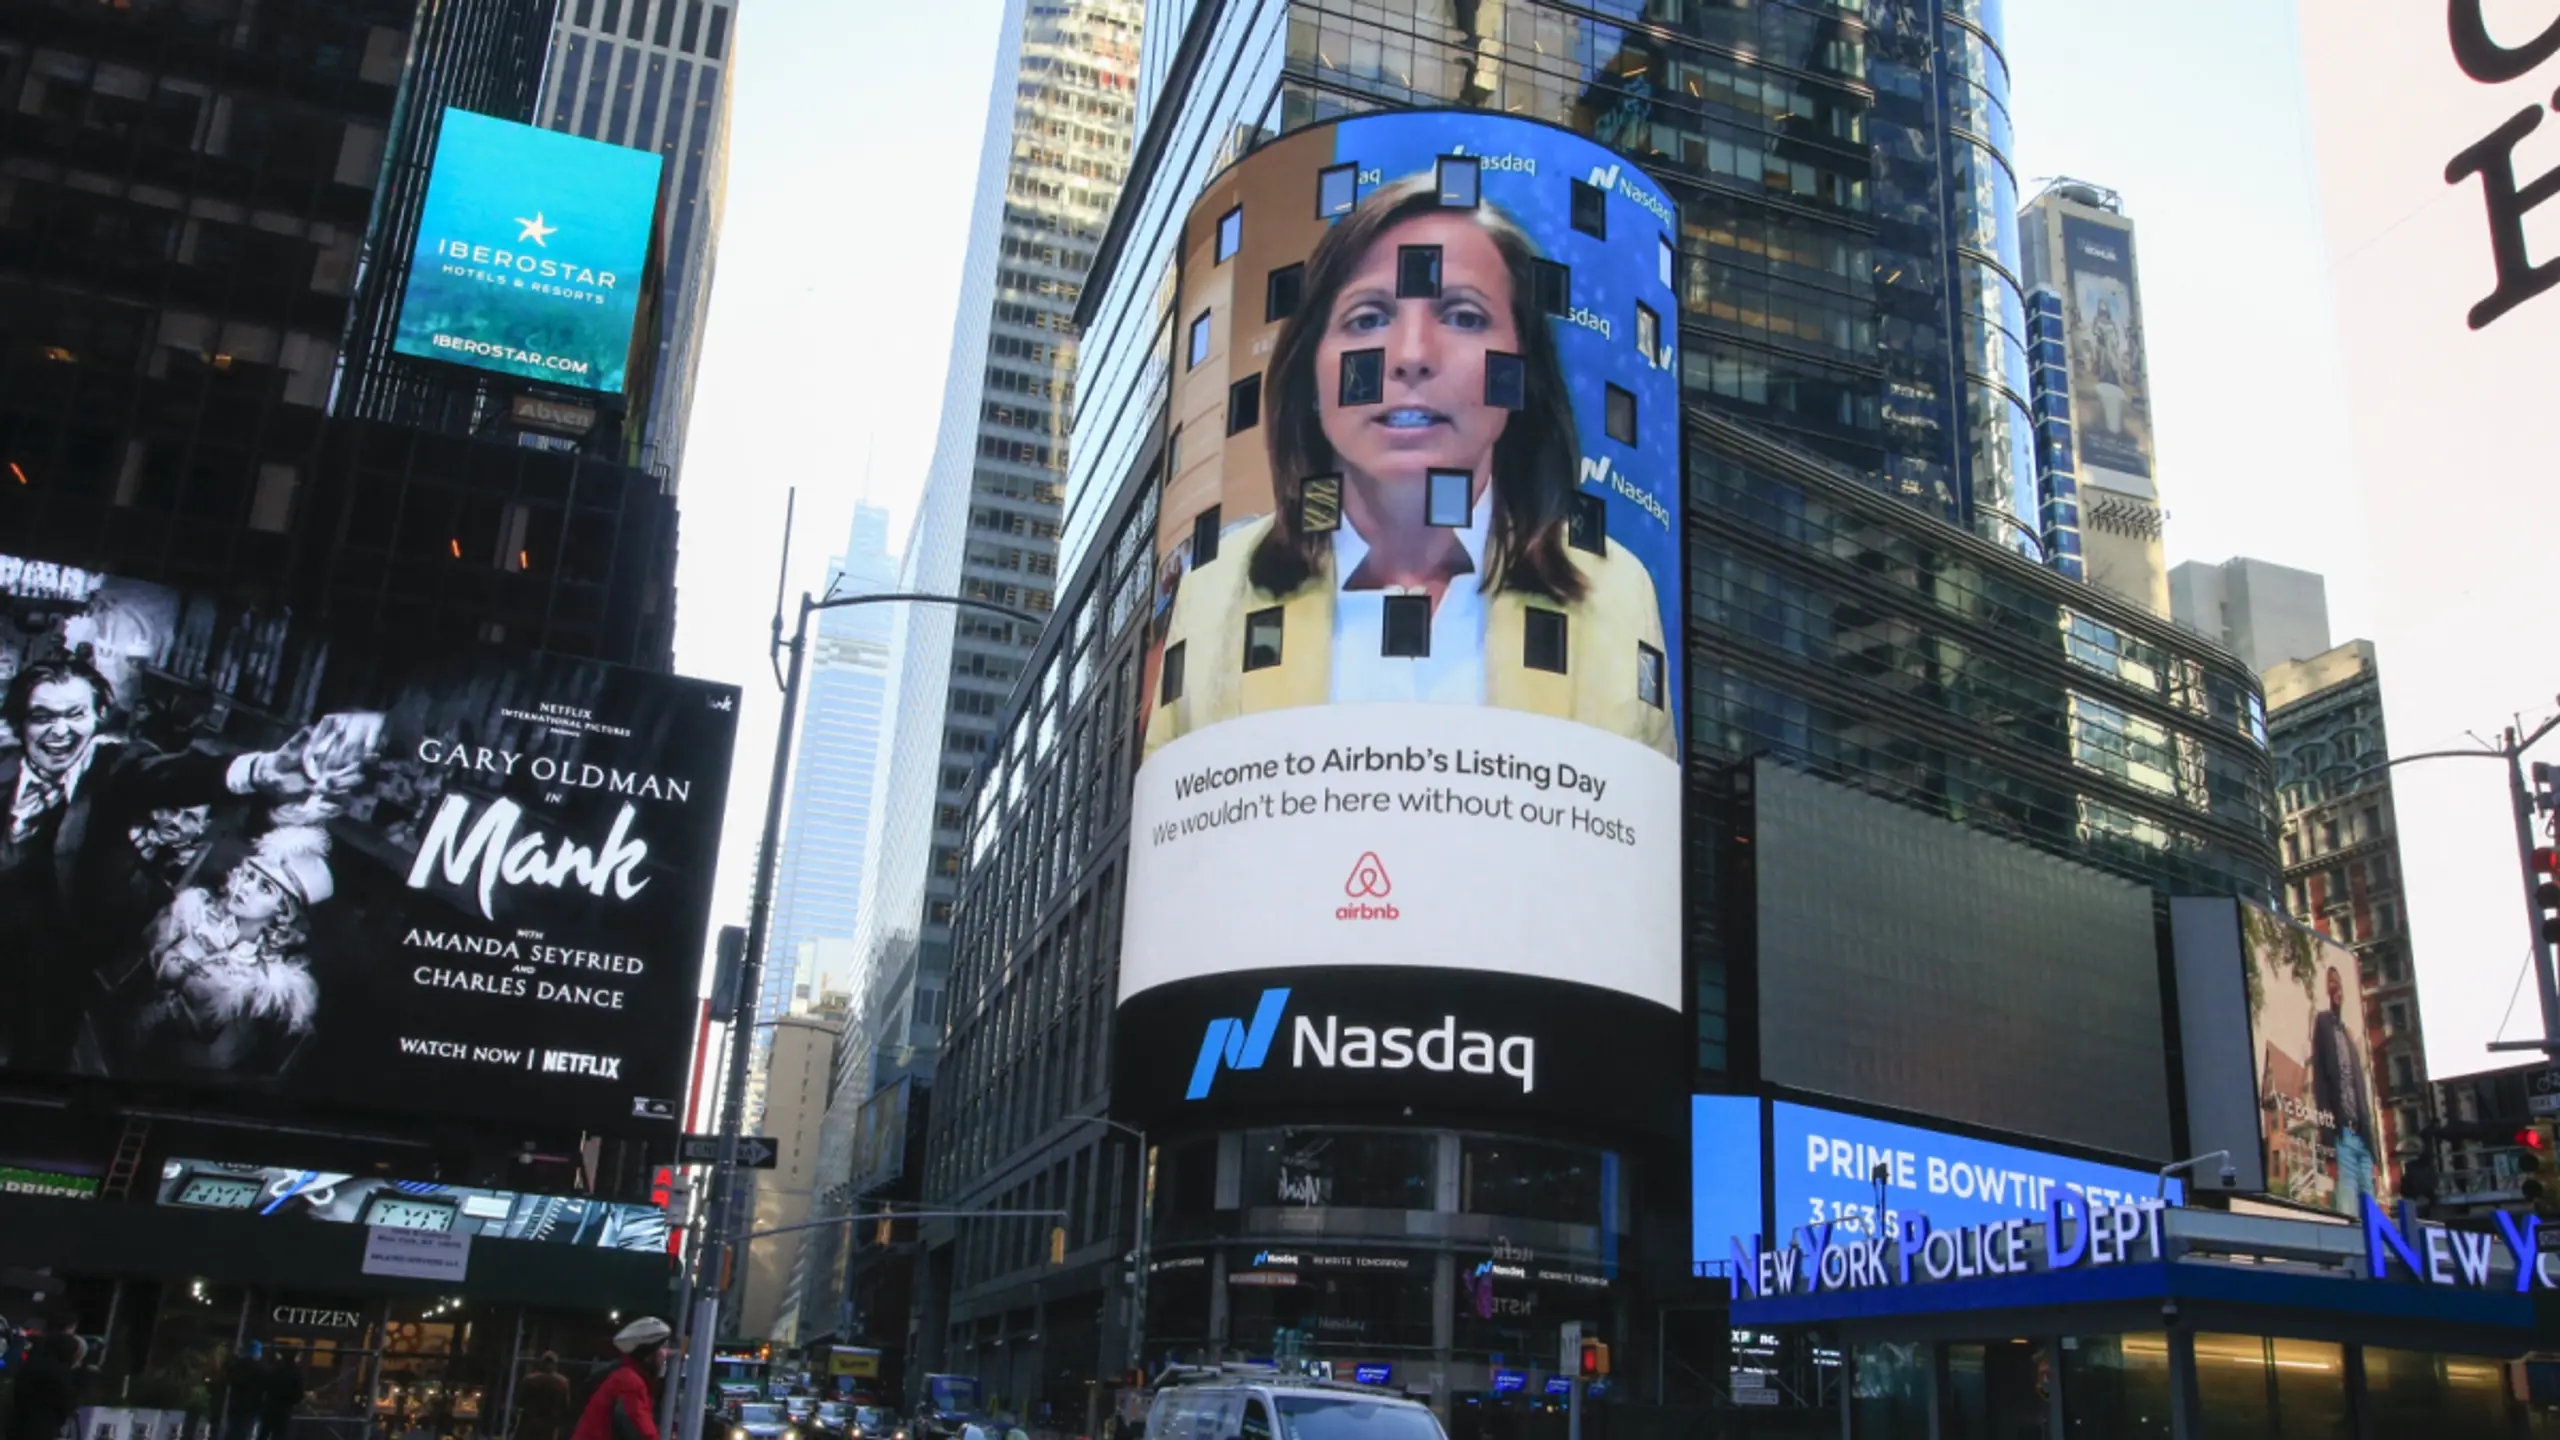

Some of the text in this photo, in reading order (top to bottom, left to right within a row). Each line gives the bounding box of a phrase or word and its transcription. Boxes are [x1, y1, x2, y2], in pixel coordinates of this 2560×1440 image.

[1468, 153, 1537, 176] asdaq
[1619, 176, 1673, 229] Nasdaq
[437, 238, 616, 289] IBEROSTAR
[442, 264, 605, 304] HOTELS & RESORTS
[1567, 306, 1612, 340] sdaq
[432, 333, 589, 374] IBEROSTAR.COM
[1611, 470, 1670, 533] Nasdaq
[501, 707, 582, 729] INTERNATIONAL
[584, 720, 632, 738] PICTURES
[539, 702, 592, 720] NETFLIX
[418, 739, 691, 802] GARY OLDMAN
[1174, 746, 1607, 801] Welcome to Airbnb's Listing Day
[545, 792, 562, 804] IN
[1151, 787, 1637, 847] We wouldn't be here without our Hosts
[406, 794, 651, 921] Mank
[1335, 902, 1400, 921] airbnb
[402, 927, 644, 975] AMANDA SEYFRIED
[516, 928, 545, 941] WITH
[413, 966, 625, 1010] CHARLES DANCE
[511, 964, 536, 975] AND
[400, 1037, 622, 1080] WATCH NOW NETFLIX
[1291, 1014, 1535, 1094] Nasdaq
[1807, 1135, 1917, 1190] PRIME
[1267, 1254, 1298, 1265] Nasdaq
[1728, 1186, 2166, 1300] NEW YORK POLICE DEPT
[2358, 1191, 2492, 1287] NEW
[272, 1305, 361, 1328] CITIZEN
